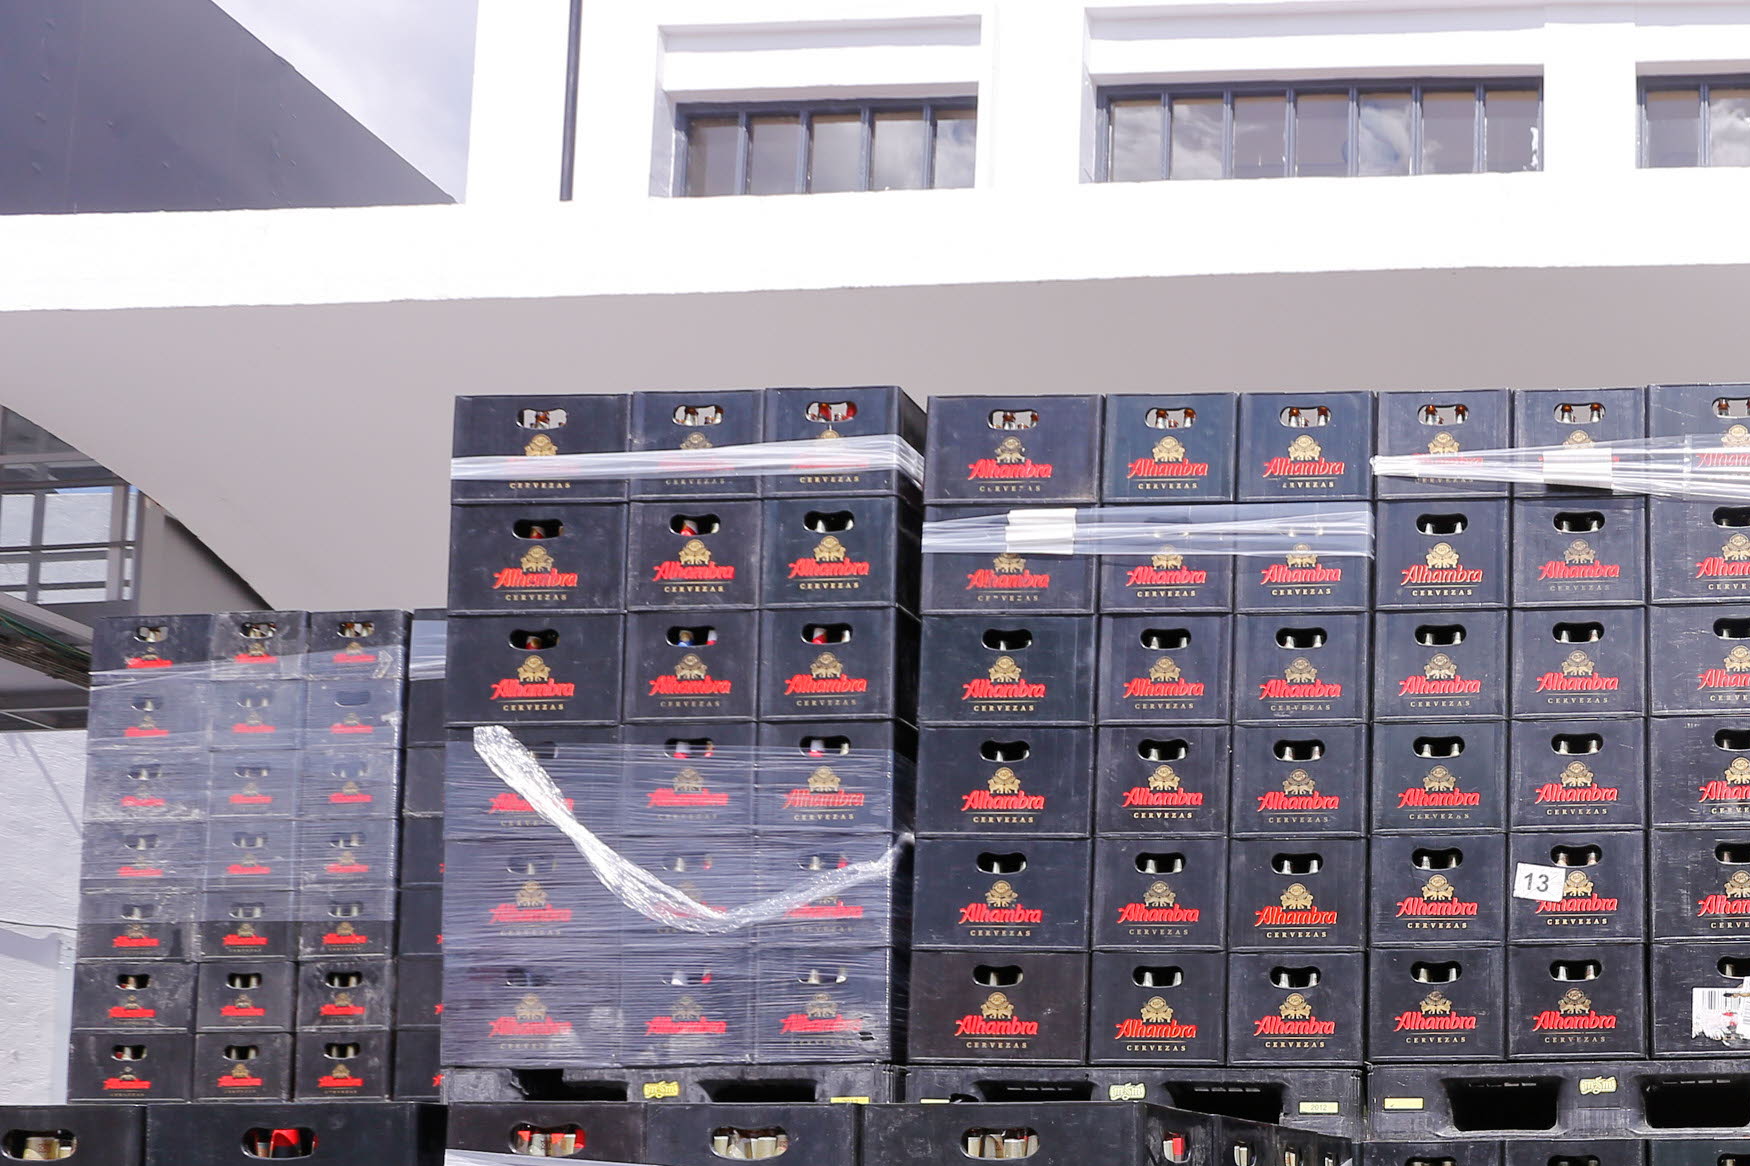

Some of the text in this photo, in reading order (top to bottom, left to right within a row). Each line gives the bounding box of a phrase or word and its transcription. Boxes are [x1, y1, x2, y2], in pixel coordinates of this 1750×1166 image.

[968, 459, 1053, 479] Alhambra
[1128, 458, 1208, 477] Alhambra
[1264, 457, 1344, 476] Alhambra
[800, 475, 859, 484] CERVEZAS
[1139, 481, 1197, 489] CERVEZAS
[652, 560, 735, 581] Alhambra
[788, 556, 870, 578] Alhambra
[1126, 565, 1207, 585] Alhambra
[1261, 564, 1341, 583] Alhambra
[1401, 564, 1482, 583] Alhambra
[1538, 560, 1620, 579] Alhambra
[493, 568, 578, 588] Alhambra
[800, 580, 858, 589] CERVEZAS
[967, 569, 1050, 589] Alhambra
[665, 584, 723, 592] CERVEZAS
[1137, 589, 1195, 597] CERVEZAS
[1272, 587, 1330, 595] CERVEZAS
[1413, 588, 1471, 596] CERVEZAS
[490, 678, 576, 699] Alhambra
[648, 675, 732, 695] Alhambra
[784, 673, 868, 695] Alhambra
[962, 678, 1046, 699] Alhambra
[1123, 678, 1205, 697] Alhambra
[1259, 679, 1342, 699] Alhambra
[1399, 675, 1481, 694] Alhambra
[1536, 672, 1619, 691] Alhambra
[503, 703, 563, 711] CERVEZAS
[974, 703, 1033, 711] CERVEZAS
[961, 789, 1046, 811] Alhambra
[1122, 787, 1204, 807] Alhambra
[1257, 791, 1340, 811] Alhambra
[1398, 788, 1481, 808] Alhambra
[1535, 783, 1618, 802] Alhambra
[973, 815, 1033, 823] CERVEZAS
[1134, 810, 1192, 818] CERVEZAS
[1547, 807, 1606, 815] CERVEZAS
[1523, 873, 1550, 893] 13
[959, 902, 1043, 923] Alhambra
[1117, 903, 1200, 923] Alhambra
[1254, 906, 1337, 925] Alhambra
[1396, 898, 1478, 918] Alhambra
[1408, 922, 1466, 930] CERVEZAS
[1547, 917, 1606, 925] CERVEZAS
[970, 928, 1030, 936] CERVEZAS
[1267, 930, 1326, 938] CERVEZAS
[954, 1014, 1040, 1038] Alhambra
[1115, 1018, 1198, 1038] Alhambra
[1254, 1015, 1335, 1035] Alhambra
[1394, 1011, 1476, 1031] Alhambra
[1532, 1010, 1617, 1030] Alhambra
[1127, 1043, 1185, 1051] CERVEZAS
[1266, 1039, 1324, 1047] CERVEZAS
[1406, 1035, 1465, 1043] CERVEZAS
